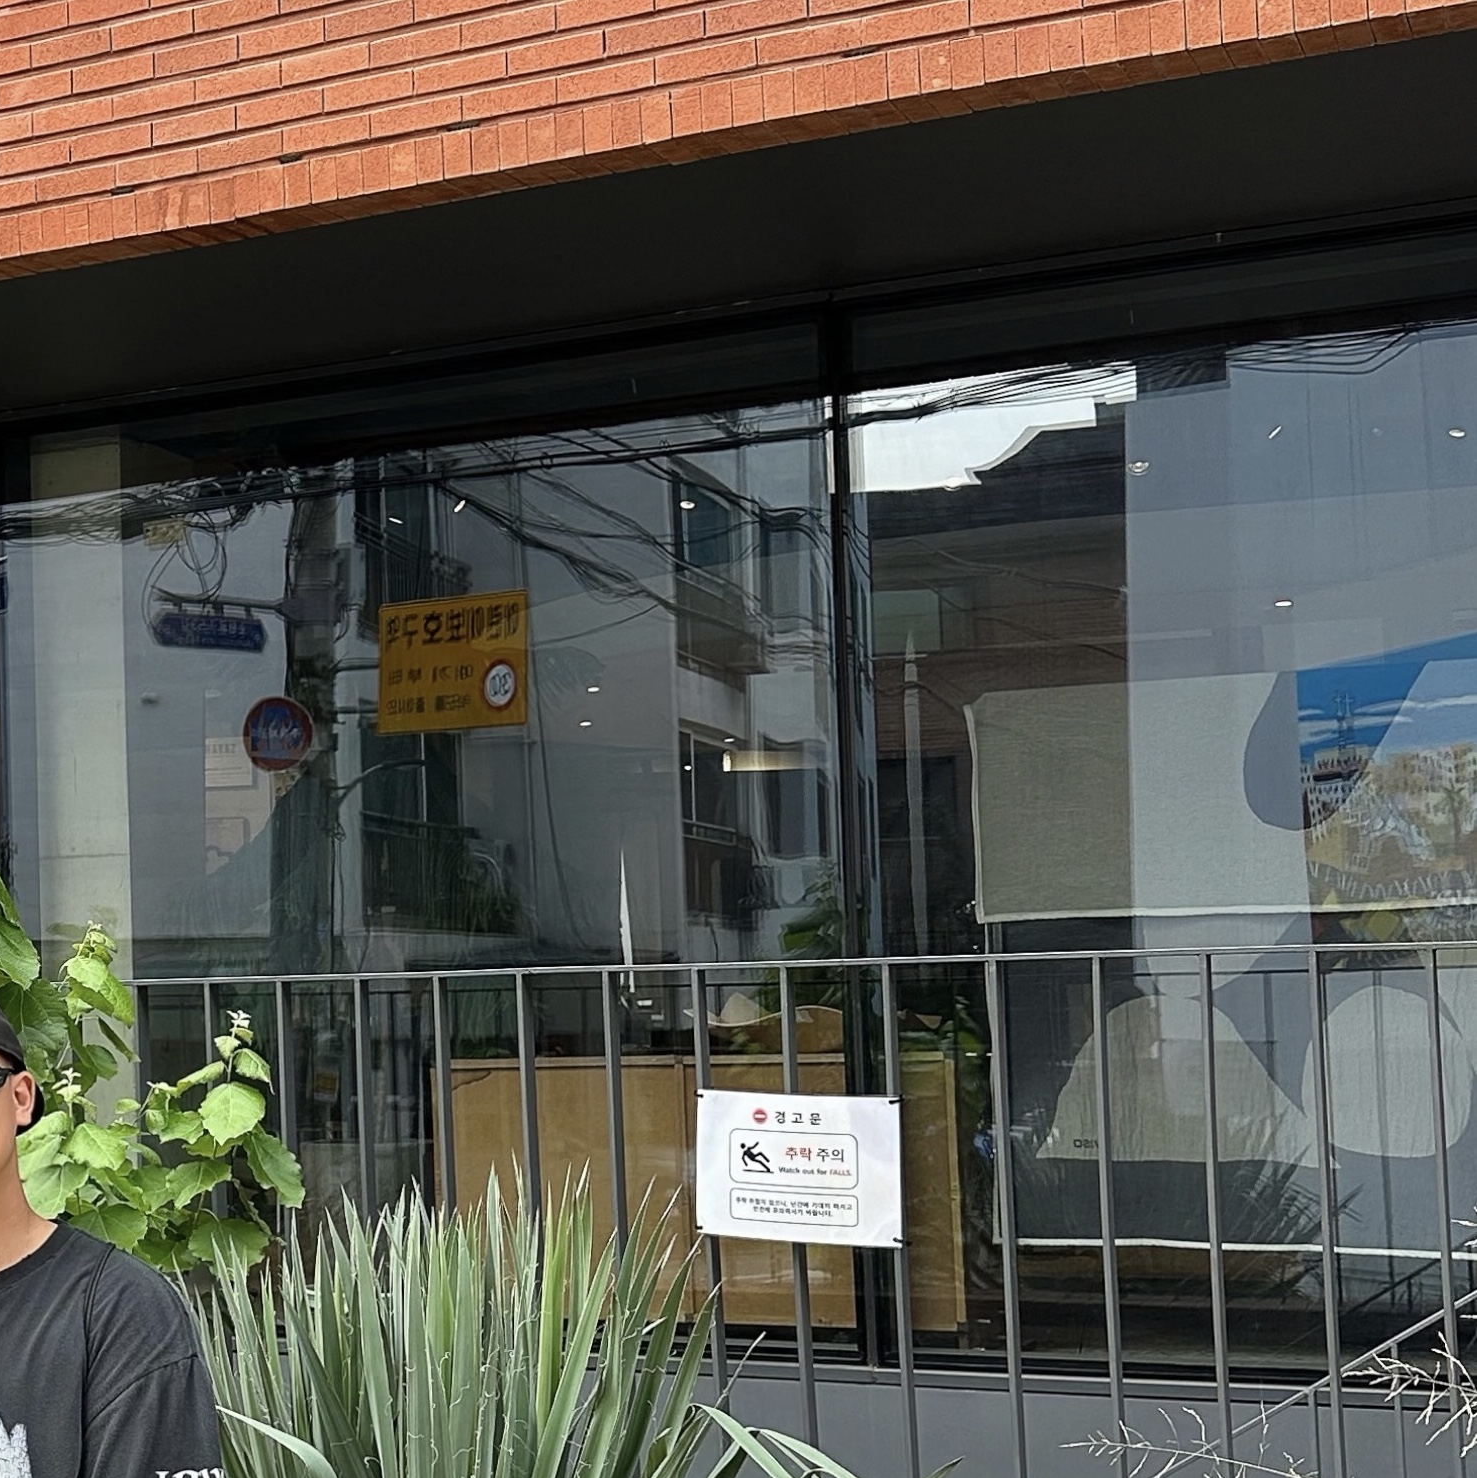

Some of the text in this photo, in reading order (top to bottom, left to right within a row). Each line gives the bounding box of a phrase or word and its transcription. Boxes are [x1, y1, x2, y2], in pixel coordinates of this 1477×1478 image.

[785, 1146, 845, 1163] 추락 주의
[778, 1166, 801, 1174] Watch
[816, 1167, 828, 1175] for
